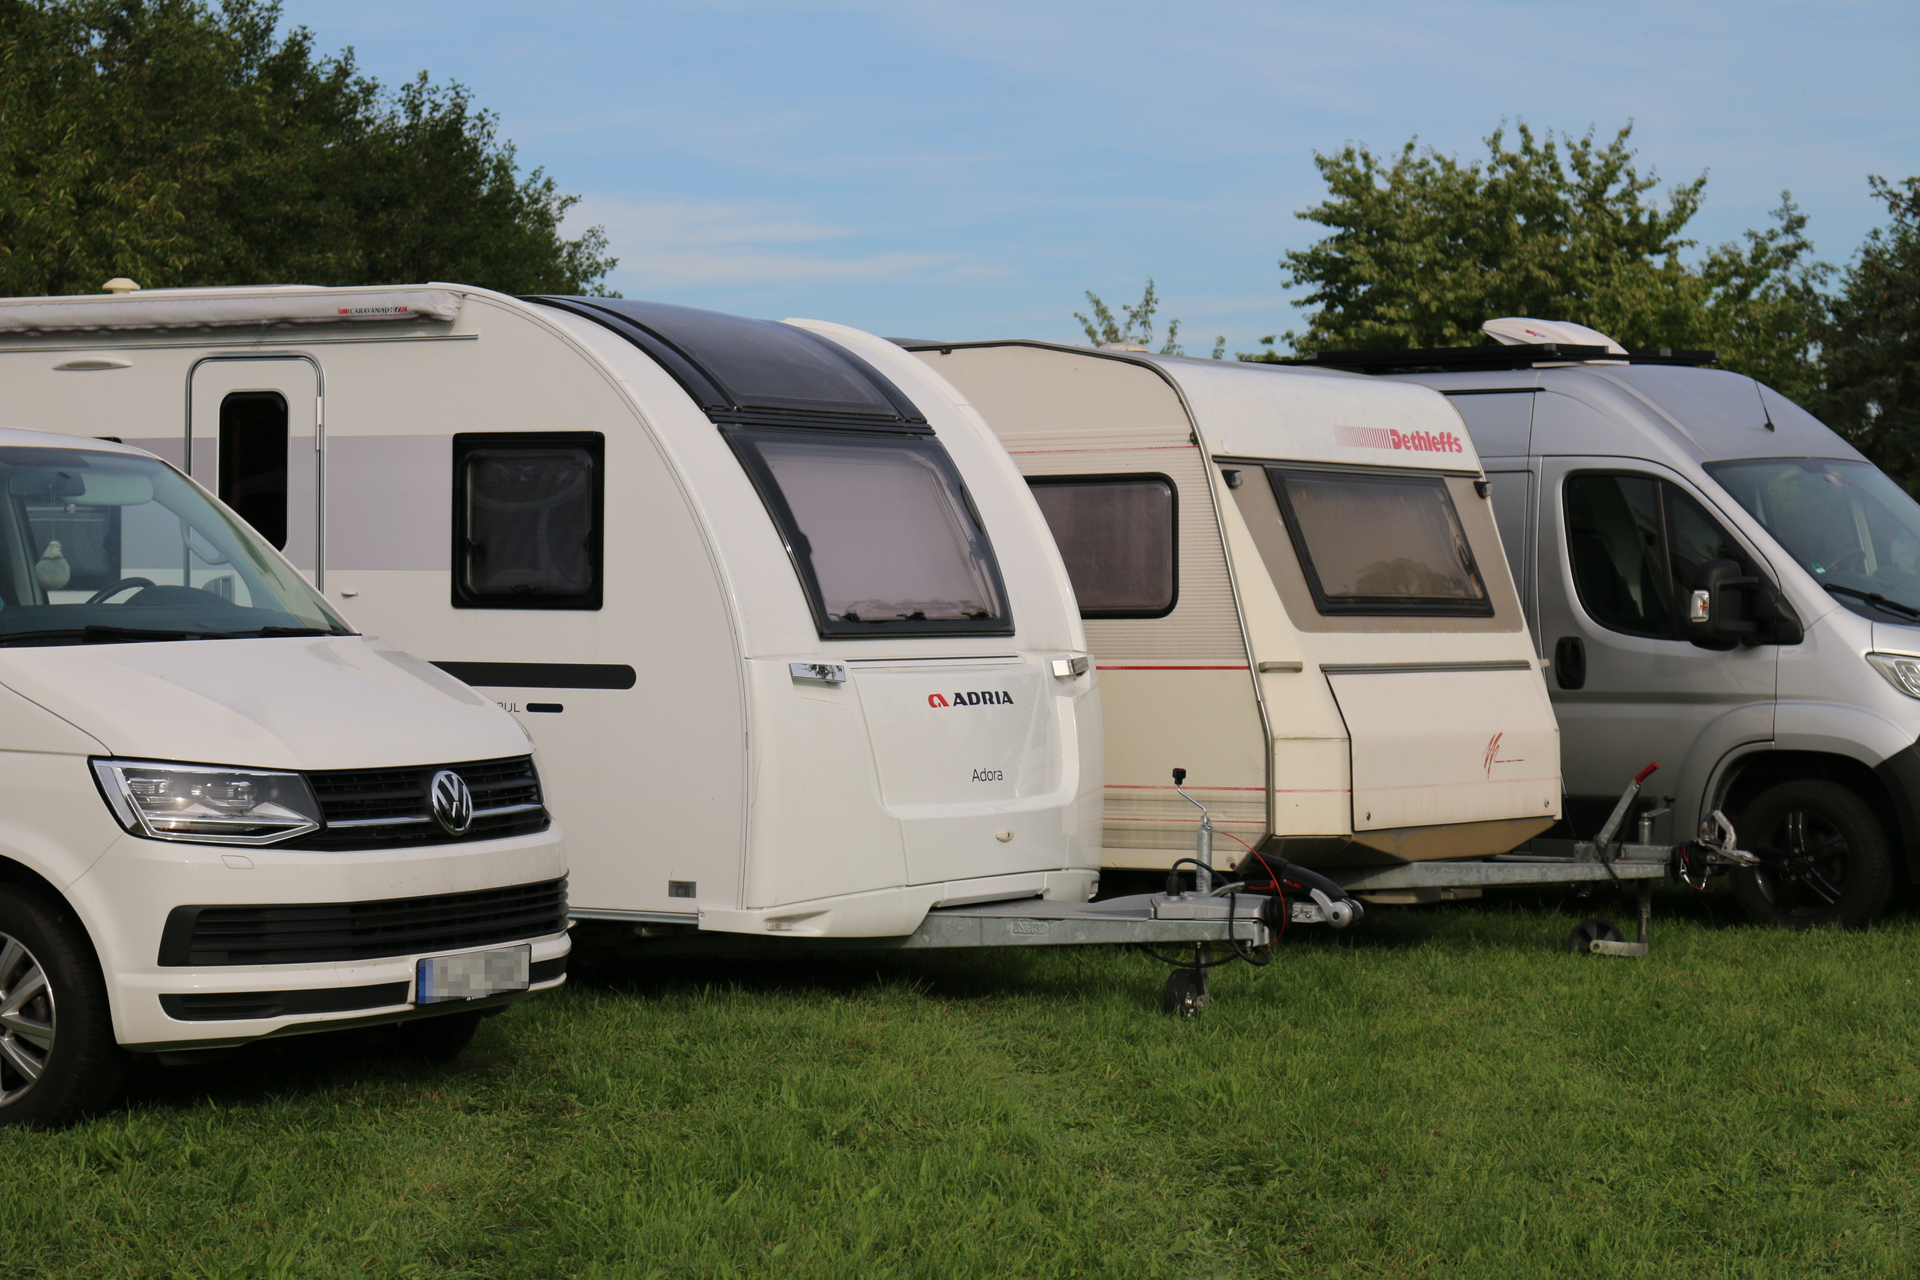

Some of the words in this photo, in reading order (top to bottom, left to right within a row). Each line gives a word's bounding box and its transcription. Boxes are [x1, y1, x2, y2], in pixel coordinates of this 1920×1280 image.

[1389, 428, 1463, 454] Dethleffs
[953, 690, 1014, 707] ADRIA
[971, 767, 1004, 783] Adora
